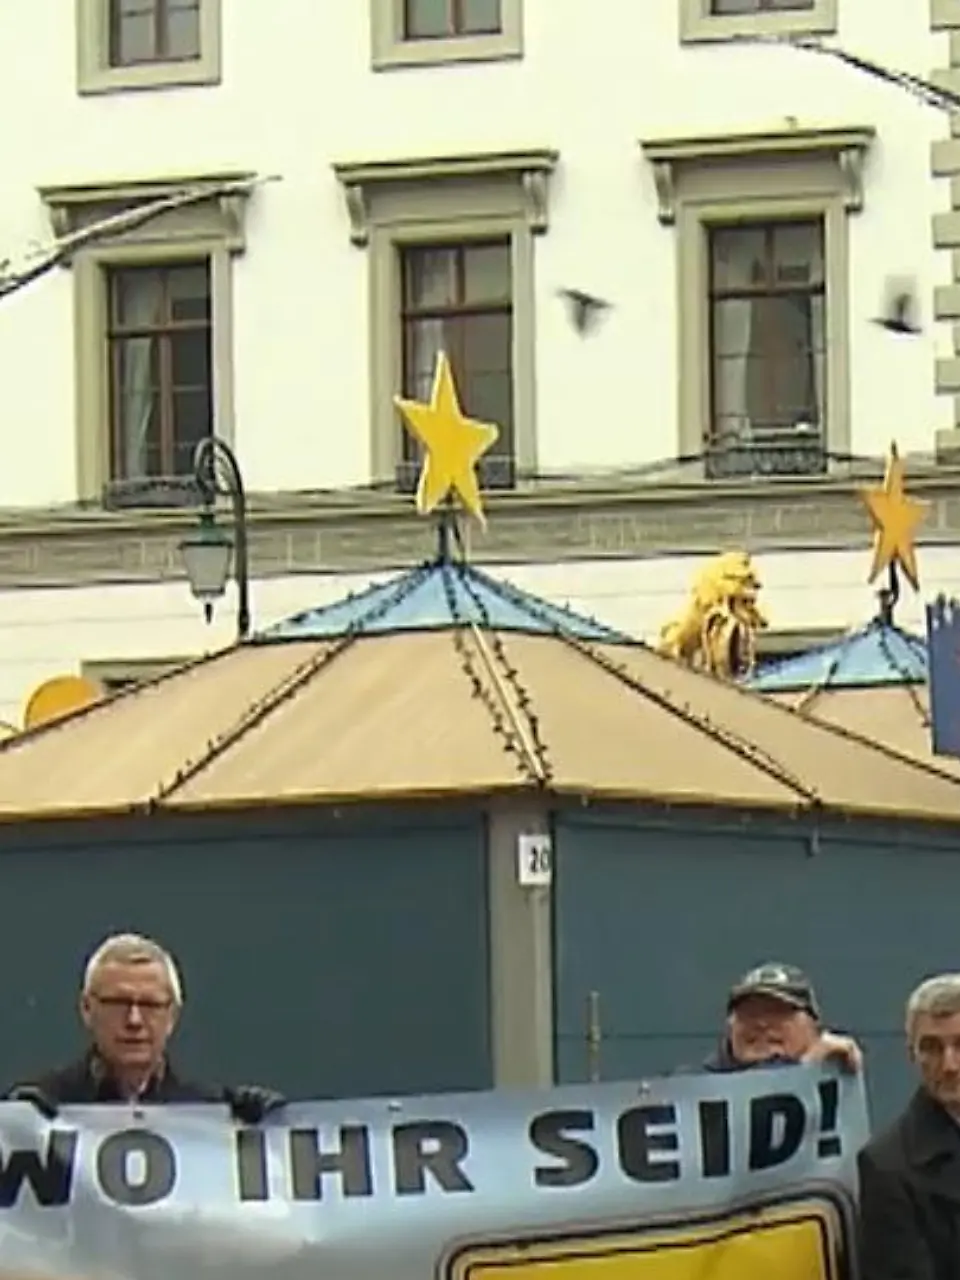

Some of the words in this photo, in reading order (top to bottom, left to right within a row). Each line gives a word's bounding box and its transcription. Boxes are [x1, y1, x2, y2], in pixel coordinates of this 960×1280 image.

[0, 1128, 177, 1208] WO
[235, 1119, 475, 1203] IHR
[528, 1079, 842, 1189] SEID!
